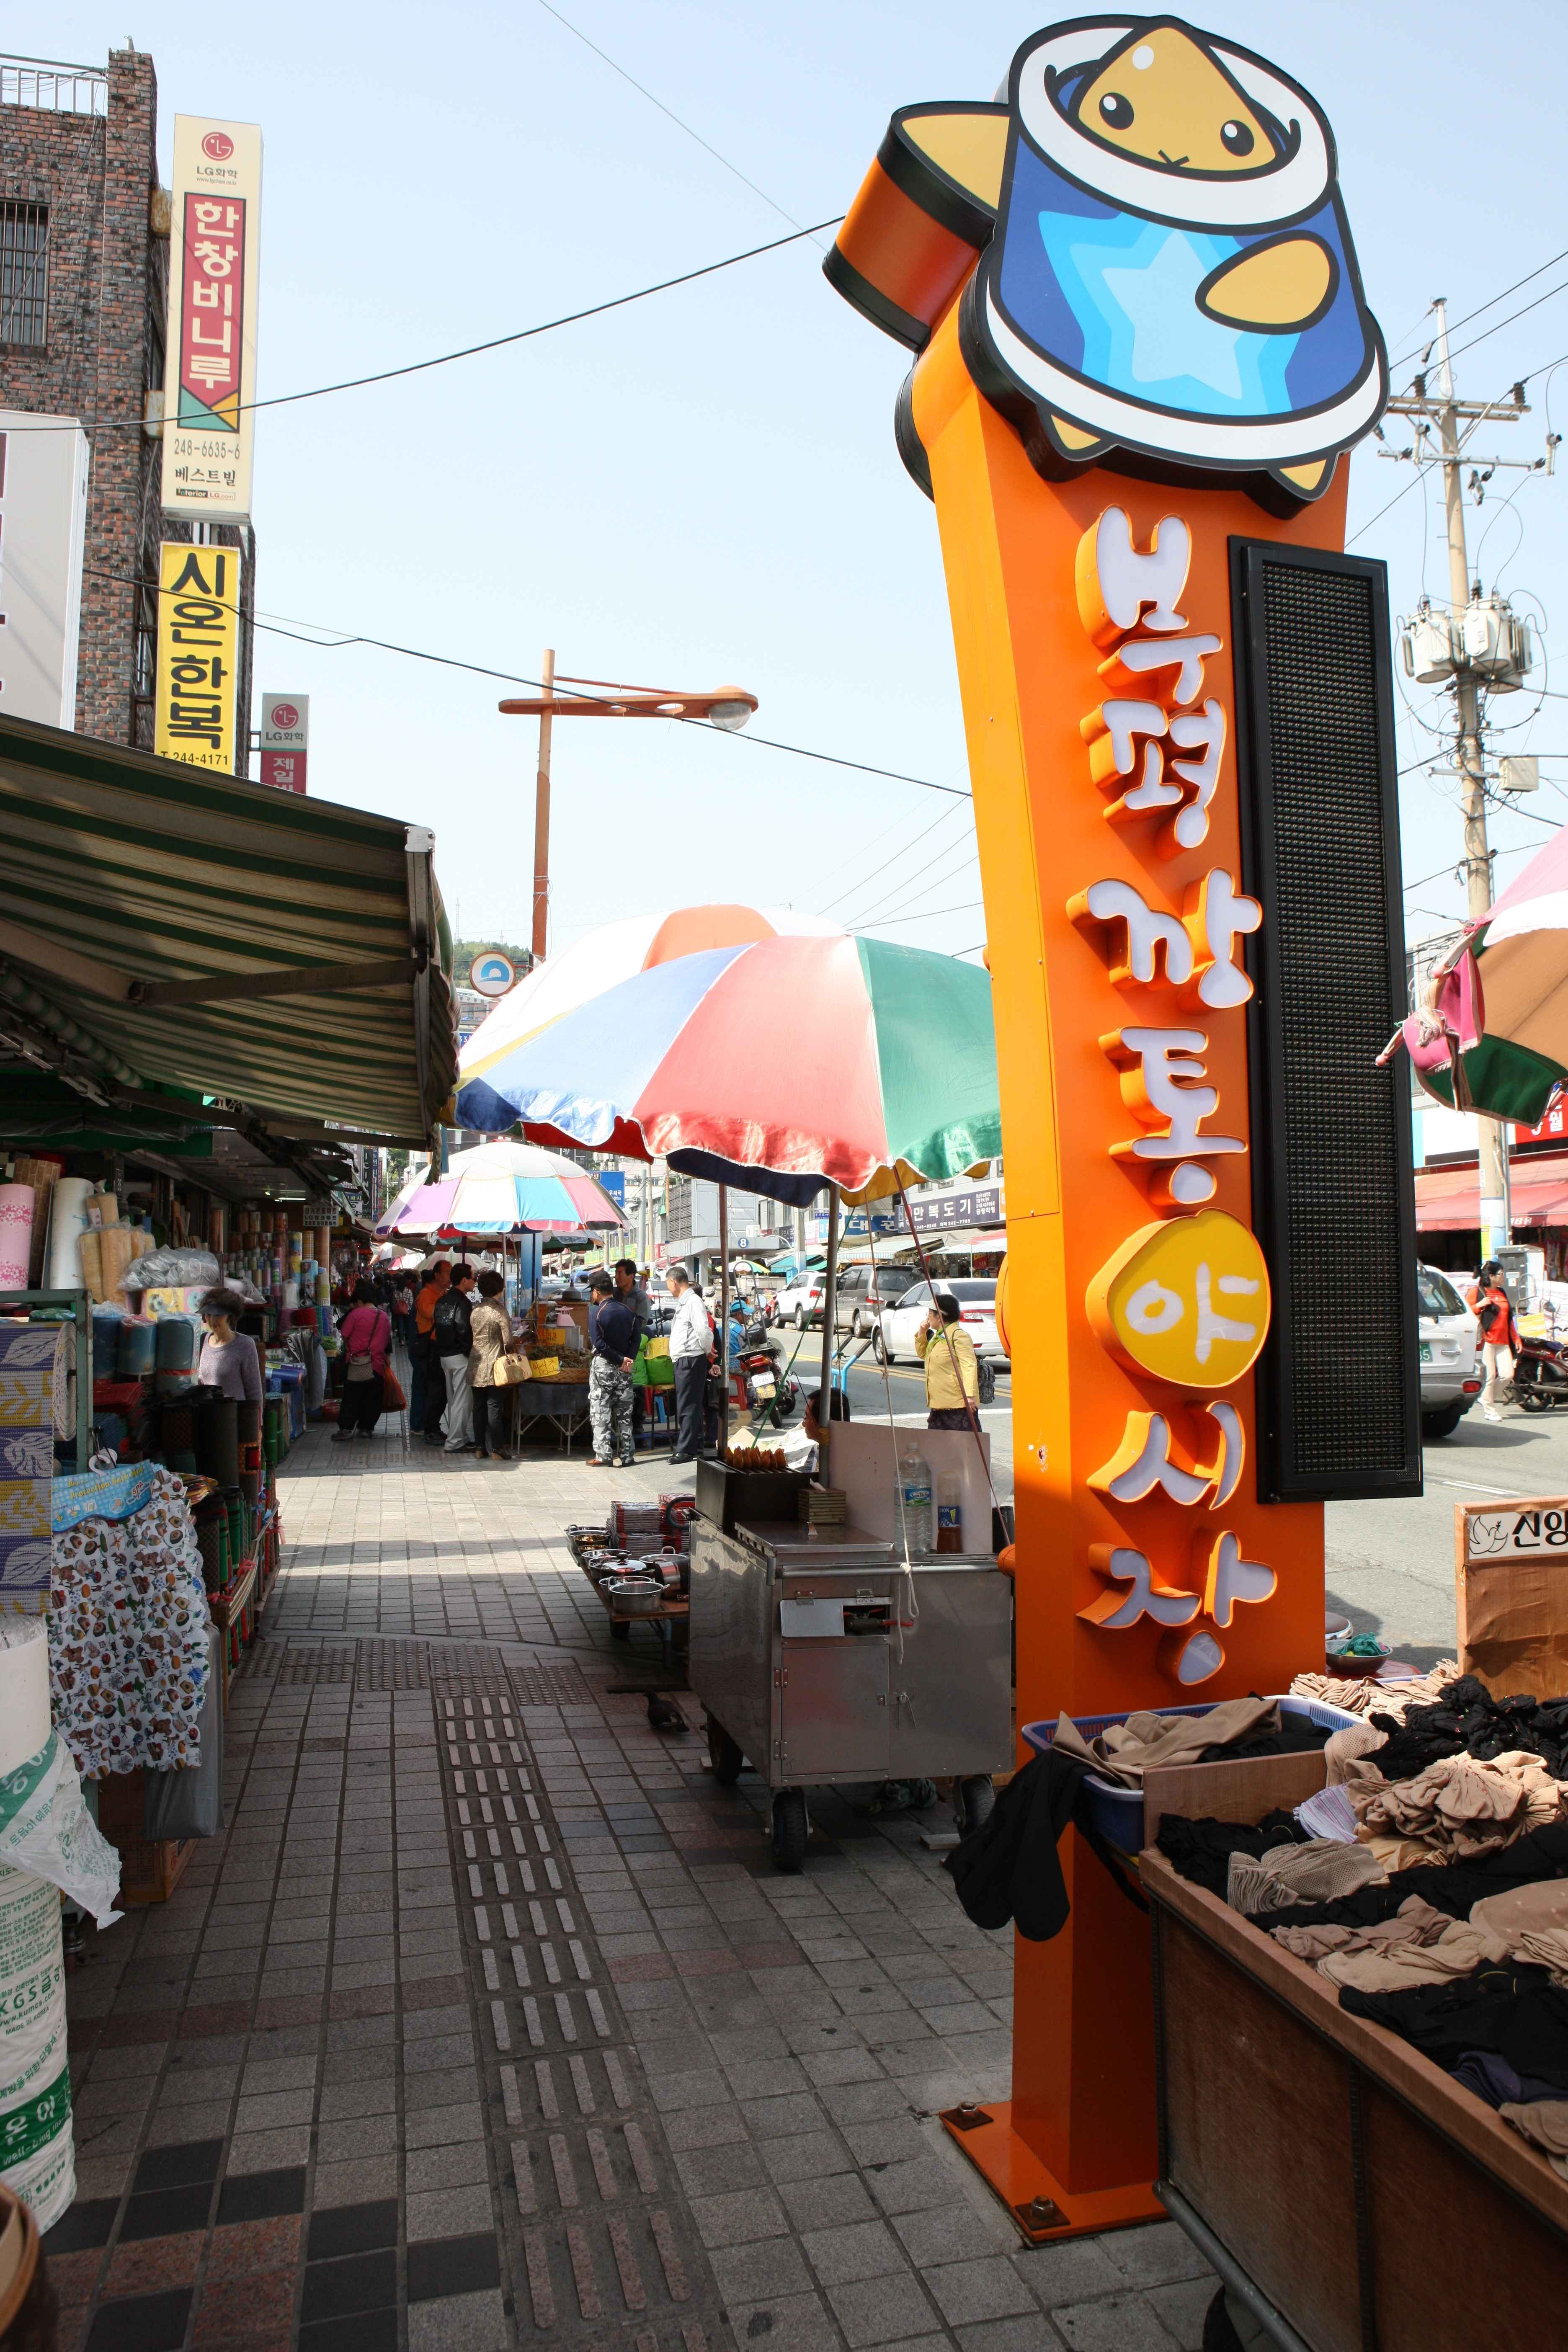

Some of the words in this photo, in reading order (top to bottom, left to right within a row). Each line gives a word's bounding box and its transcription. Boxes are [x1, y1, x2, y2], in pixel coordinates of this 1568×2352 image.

[196, 166, 237, 179] LG화학
[189, 202, 239, 389] 한창비니루
[175, 466, 236, 487] 베스트빌
[167, 552, 228, 750] 시온한복
[266, 732, 304, 741] LG화학
[913, 1198, 971, 1222] 만복도기
[740, 1238, 747, 1247] 8
[5, 2023, 25, 2035] MADE
[34, 2006, 49, 2021] KOREA
